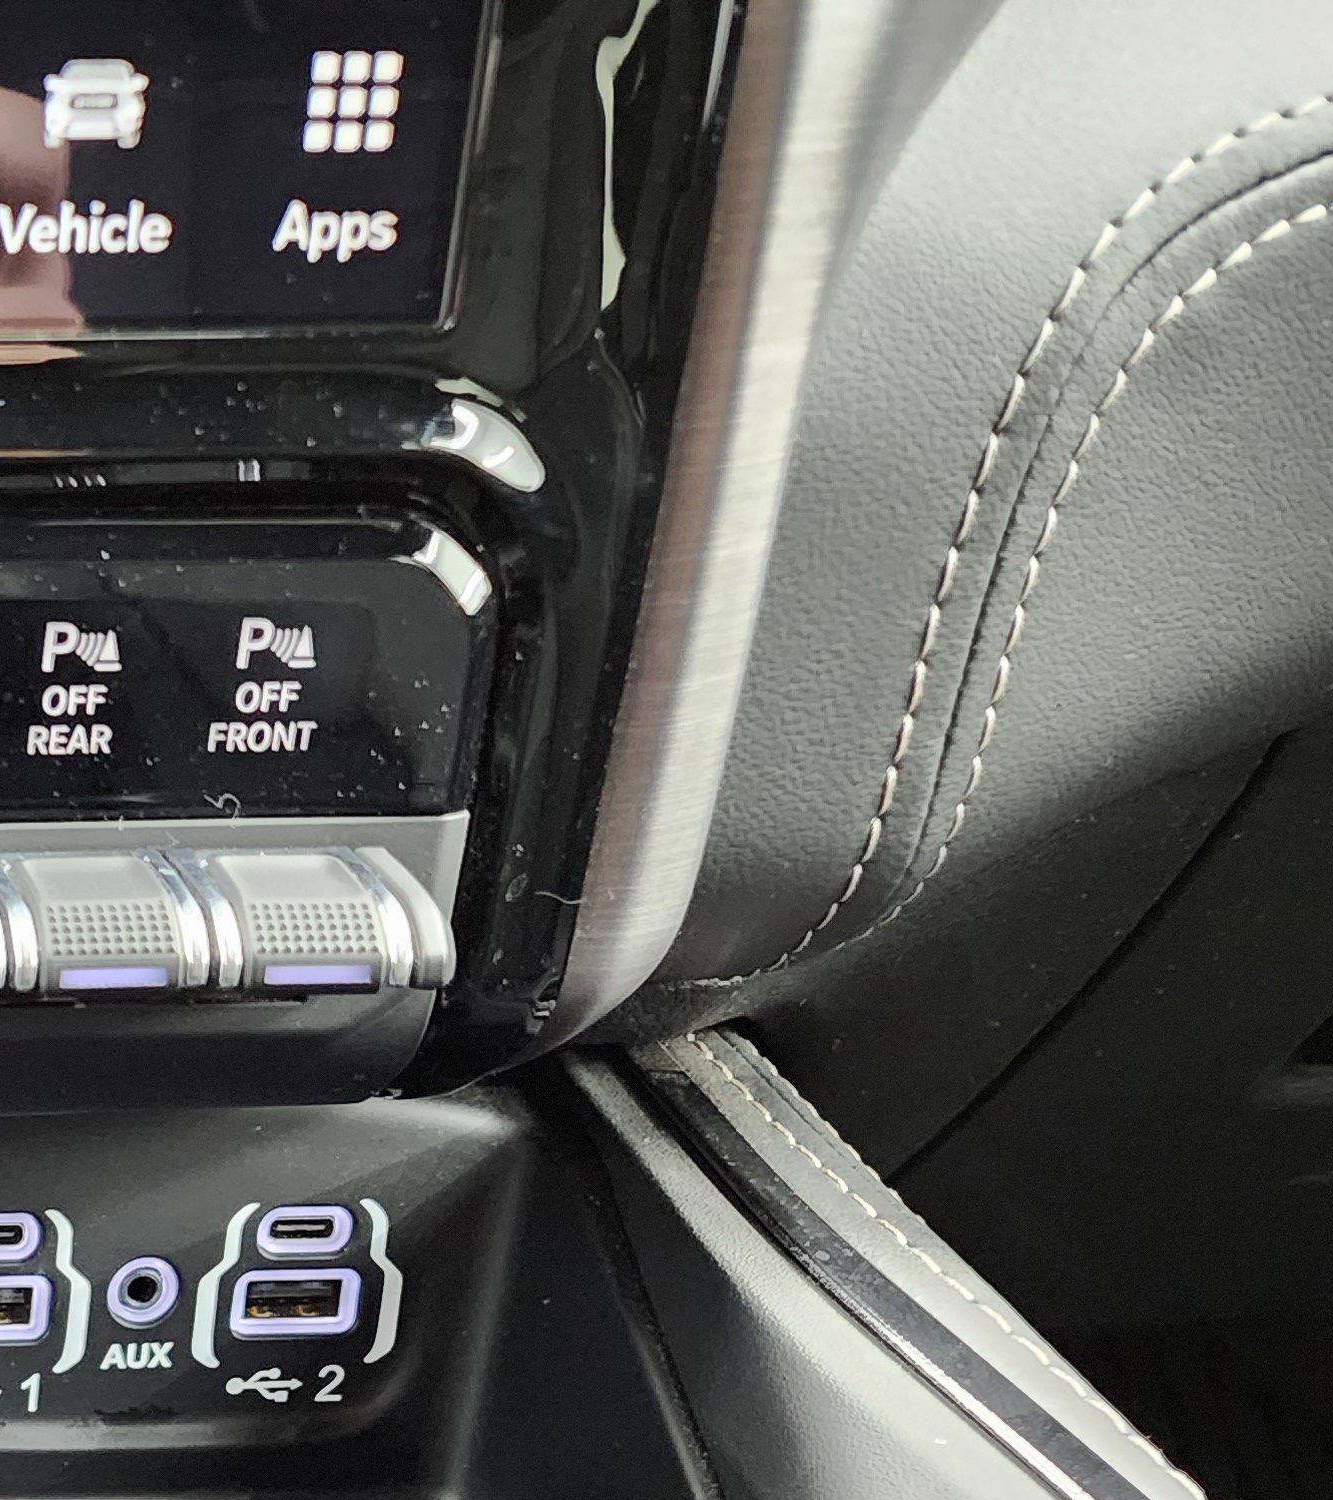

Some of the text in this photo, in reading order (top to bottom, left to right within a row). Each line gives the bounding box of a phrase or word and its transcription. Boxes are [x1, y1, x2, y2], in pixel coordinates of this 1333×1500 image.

[271, 199, 399, 264] Apps
[41, 683, 109, 717] OFF
[235, 680, 302, 714] OFF
[26, 723, 113, 756] REAR
[207, 720, 318, 753] FRONT
[99, 1341, 175, 1371] AUX
[20, 1372, 41, 1413] 1
[313, 1364, 346, 1403] 2
